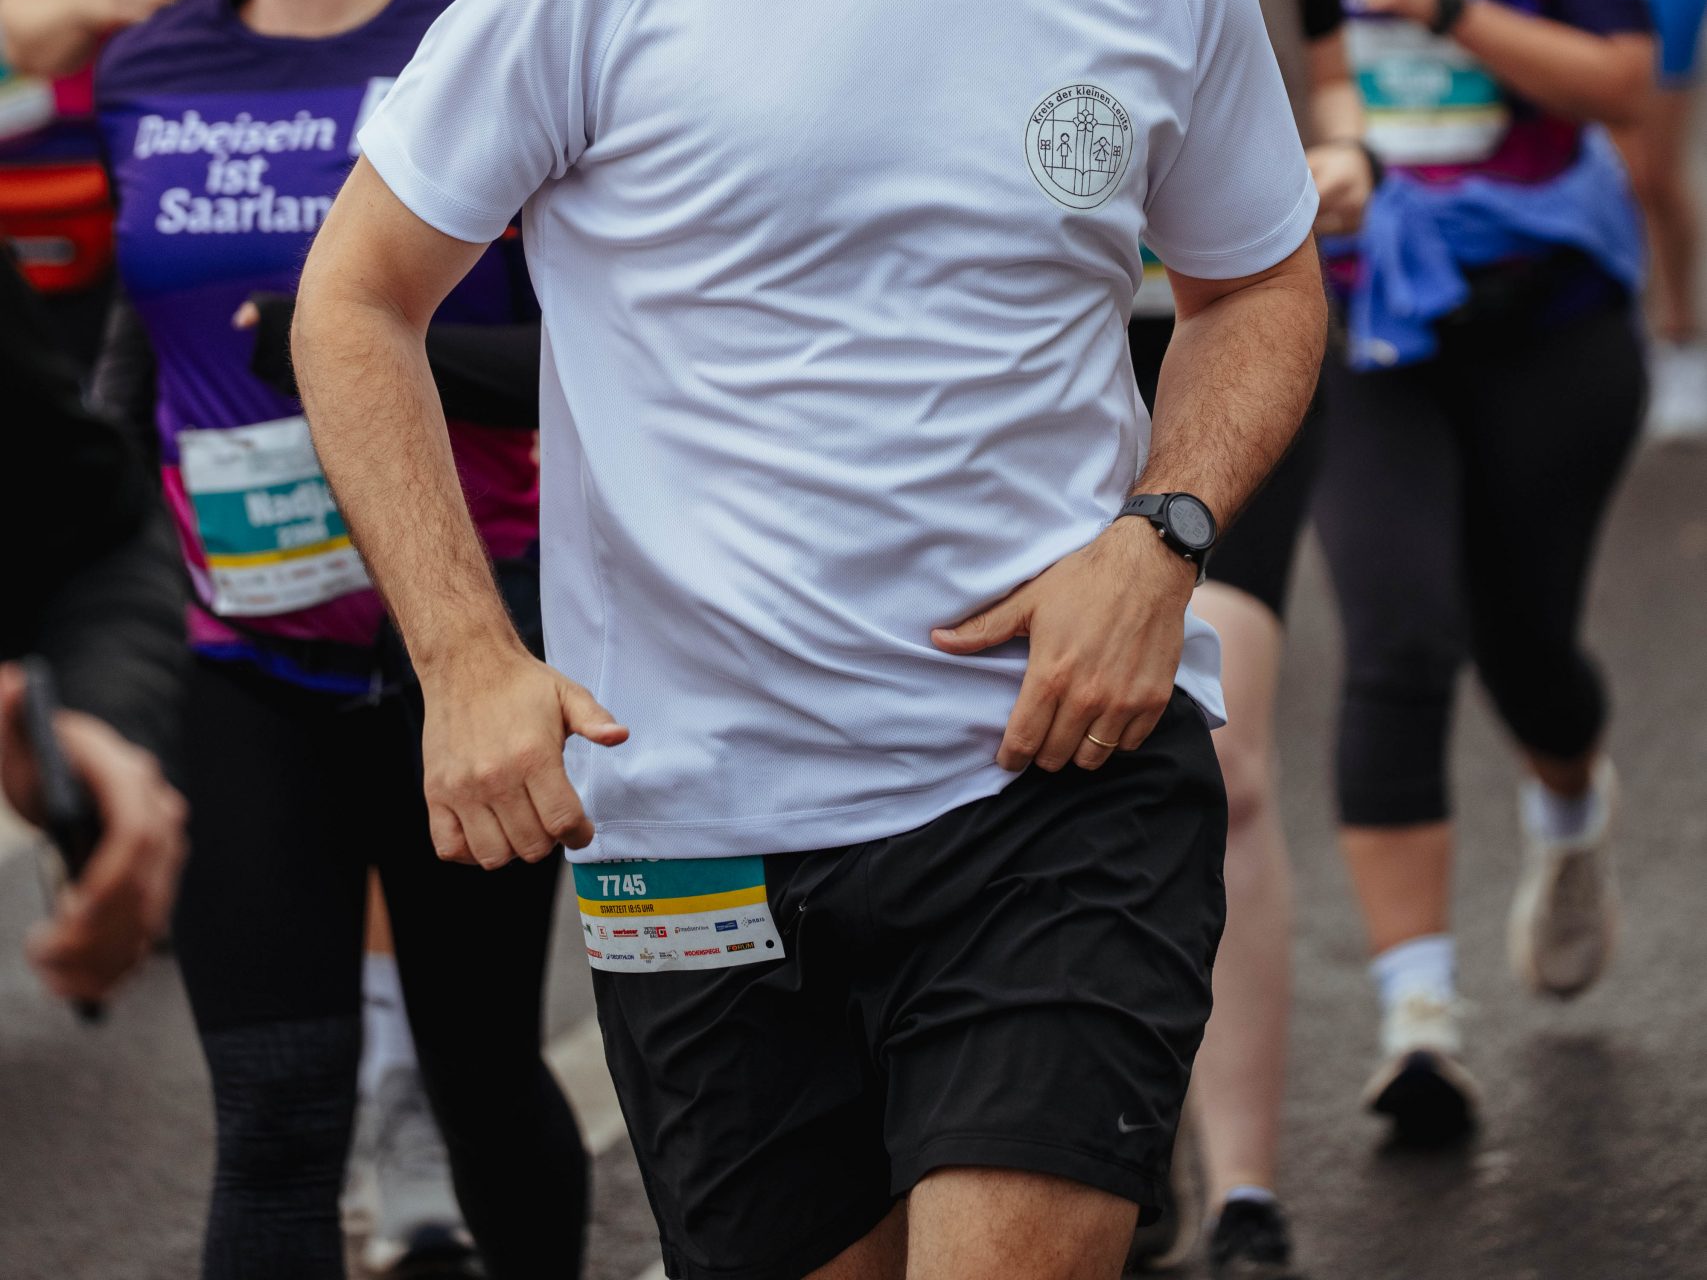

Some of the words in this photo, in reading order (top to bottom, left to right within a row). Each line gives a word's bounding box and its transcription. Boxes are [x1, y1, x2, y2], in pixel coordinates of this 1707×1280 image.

[1032, 100, 1054, 124] Kreis
[1056, 90, 1073, 103] der
[1076, 86, 1111, 105] kleinen
[1111, 102, 1129, 132] Leute
[207, 151, 268, 195] ist
[156, 186, 333, 234] Saarlan
[597, 873, 647, 897] 7745
[600, 904, 627, 914] STARTZEIT
[627, 904, 641, 913] 18:15
[641, 903, 655, 913] UHR
[683, 948, 721, 957] WOCHENSPIEGEL
[727, 941, 755, 952] FORUM
